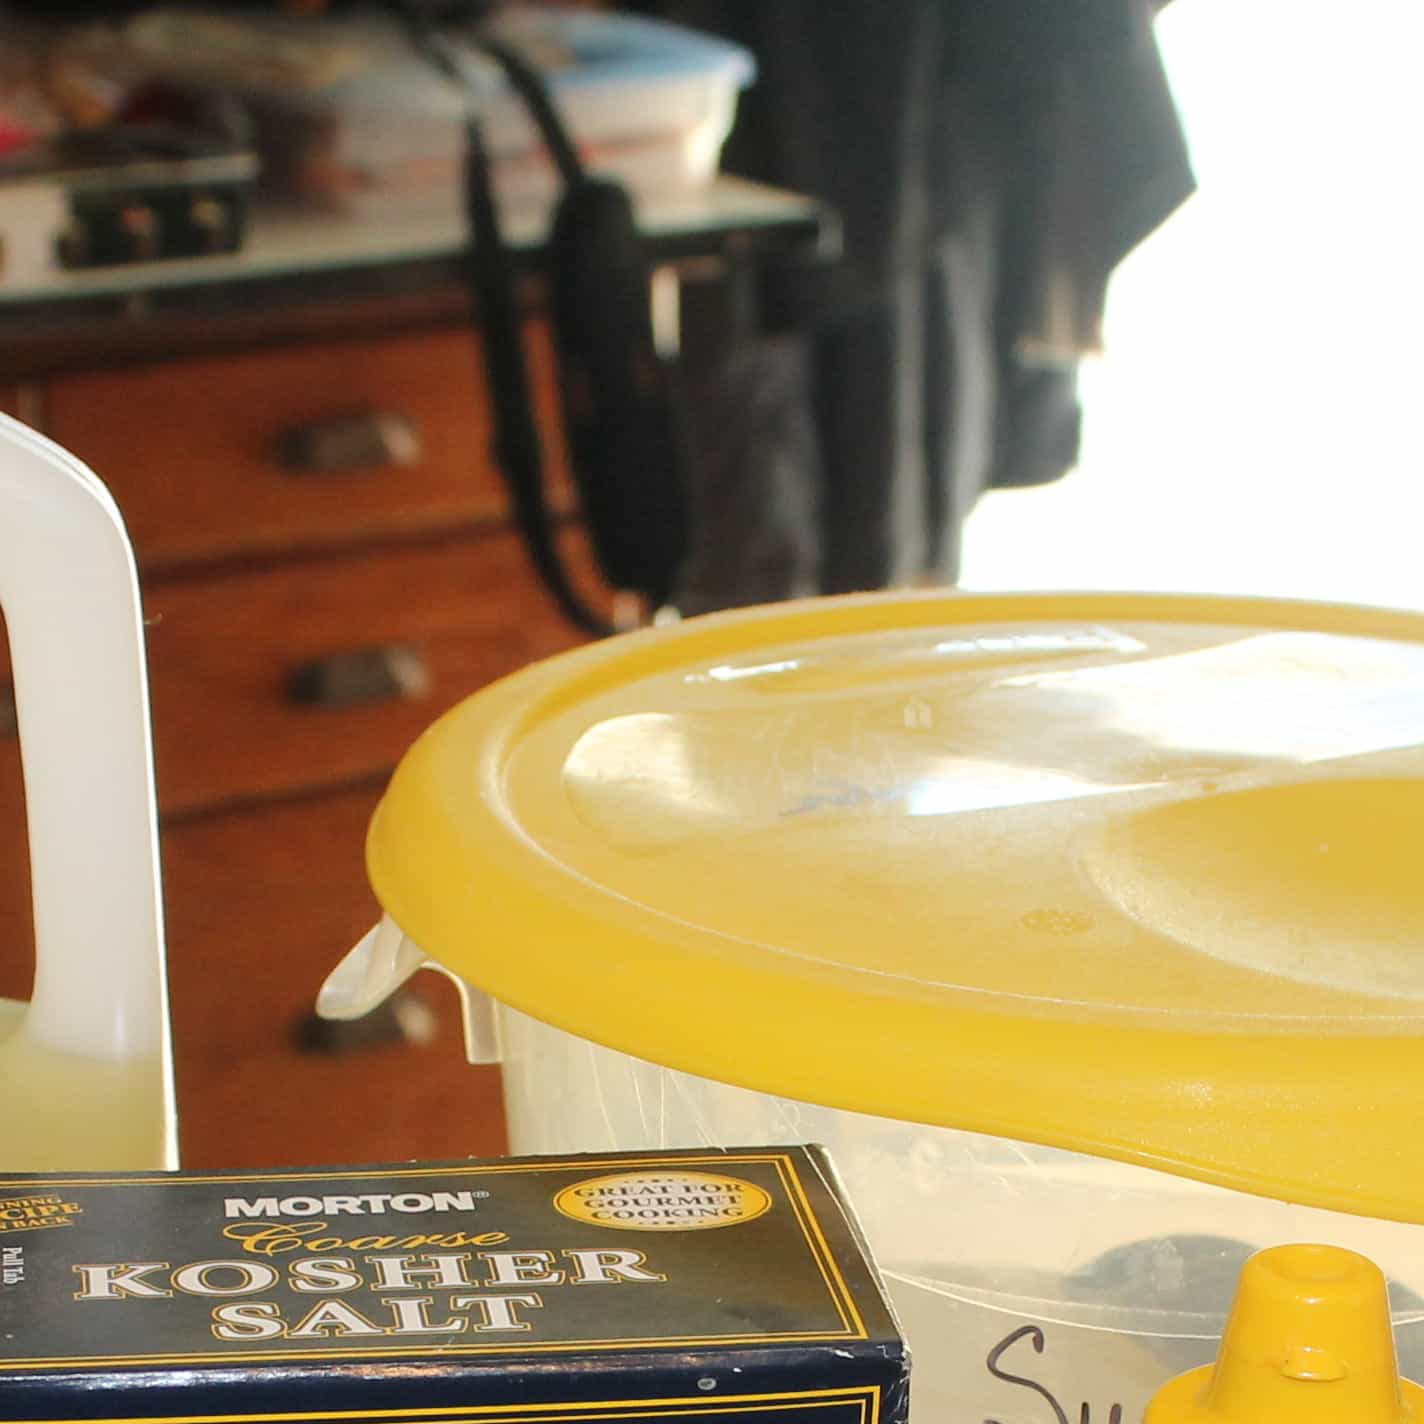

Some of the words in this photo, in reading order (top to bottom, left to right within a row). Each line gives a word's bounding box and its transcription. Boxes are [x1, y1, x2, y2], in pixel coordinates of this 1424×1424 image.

[574, 1185, 667, 1198] GREAT
[675, 1182, 744, 1196] FOR
[224, 1190, 476, 1218] MORTON
[583, 1194, 740, 1208] GOURMET
[591, 1206, 744, 1220] COOKING
[0, 1214, 72, 1232] BACK
[222, 1222, 511, 1257] Coarse
[2, 1247, 25, 1266] Pull
[73, 1247, 668, 1301] KOSHER
[210, 1292, 545, 1342] SALT
